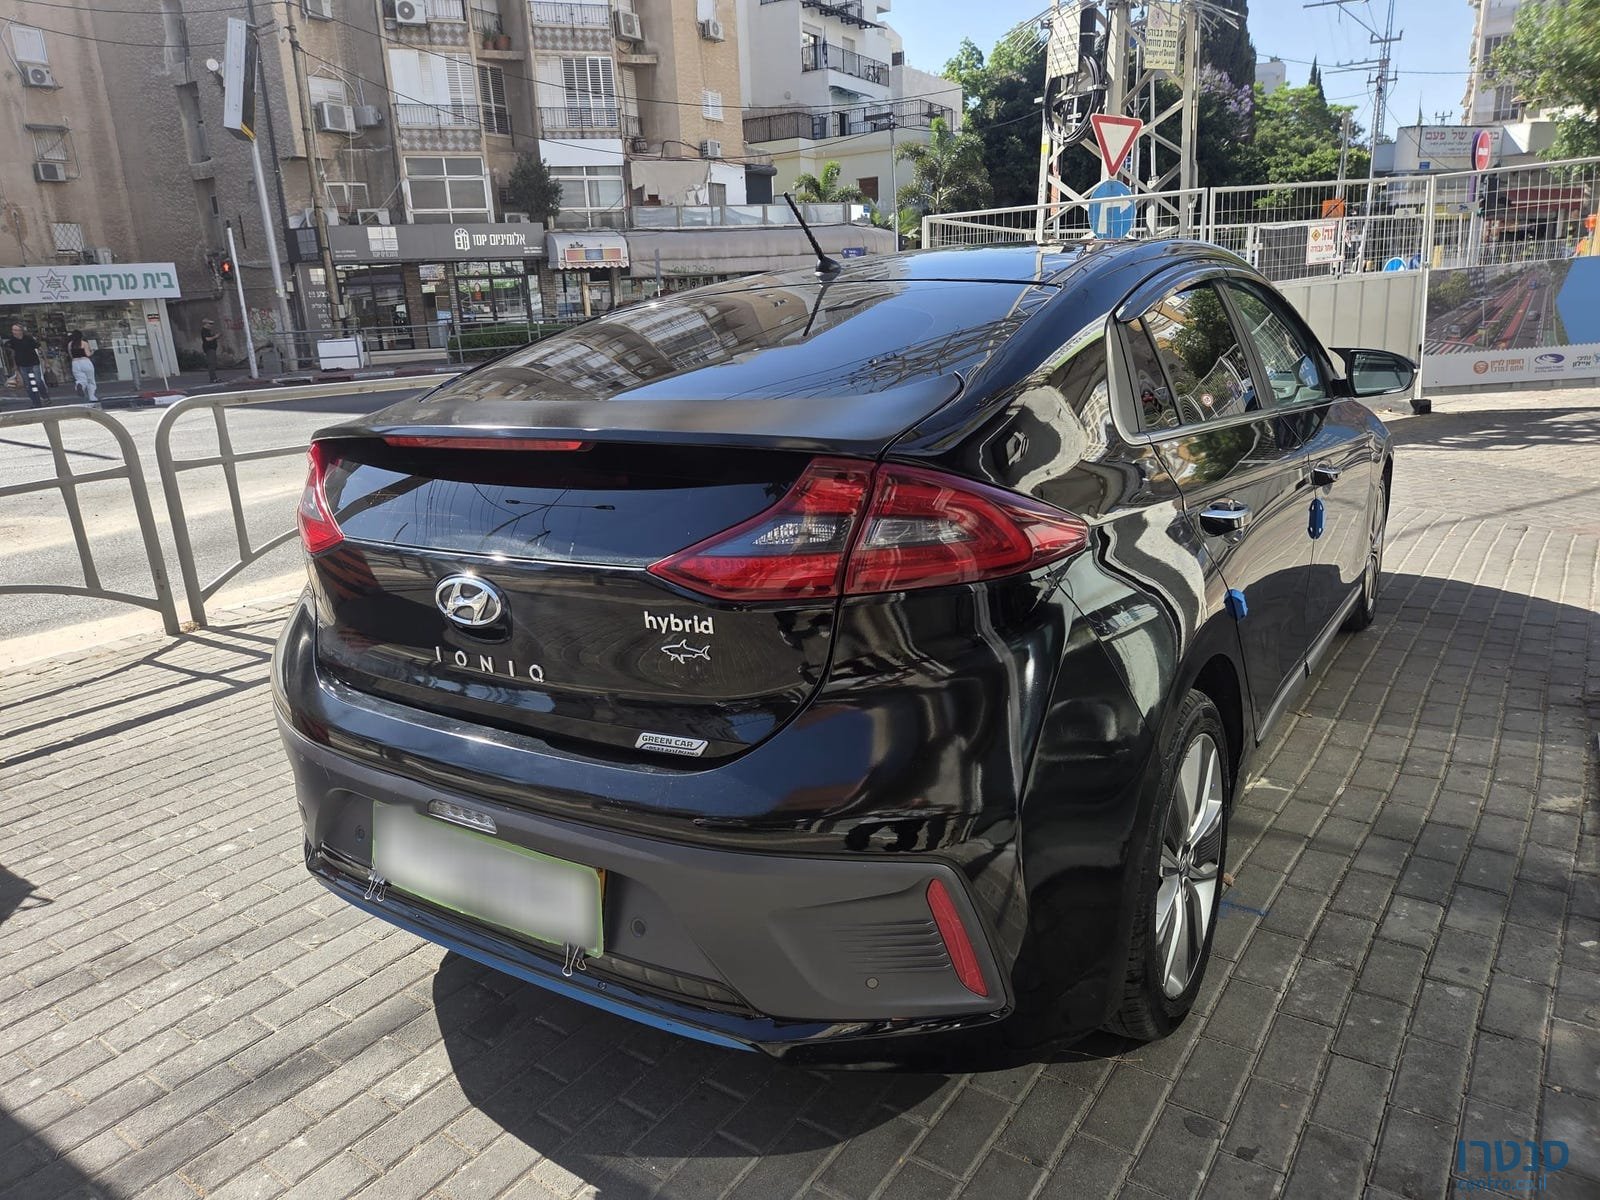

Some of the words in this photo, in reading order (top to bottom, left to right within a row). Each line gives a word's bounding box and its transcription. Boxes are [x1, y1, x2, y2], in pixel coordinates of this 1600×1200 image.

[489, 231, 526, 246] אלומיניום
[73, 272, 138, 296] מרקחת
[142, 271, 175, 290] בית
[643, 610, 714, 635] hybrid
[435, 645, 545, 683] IONIQ
[641, 735, 673, 745] GREEN
[674, 739, 694, 748] CAR
